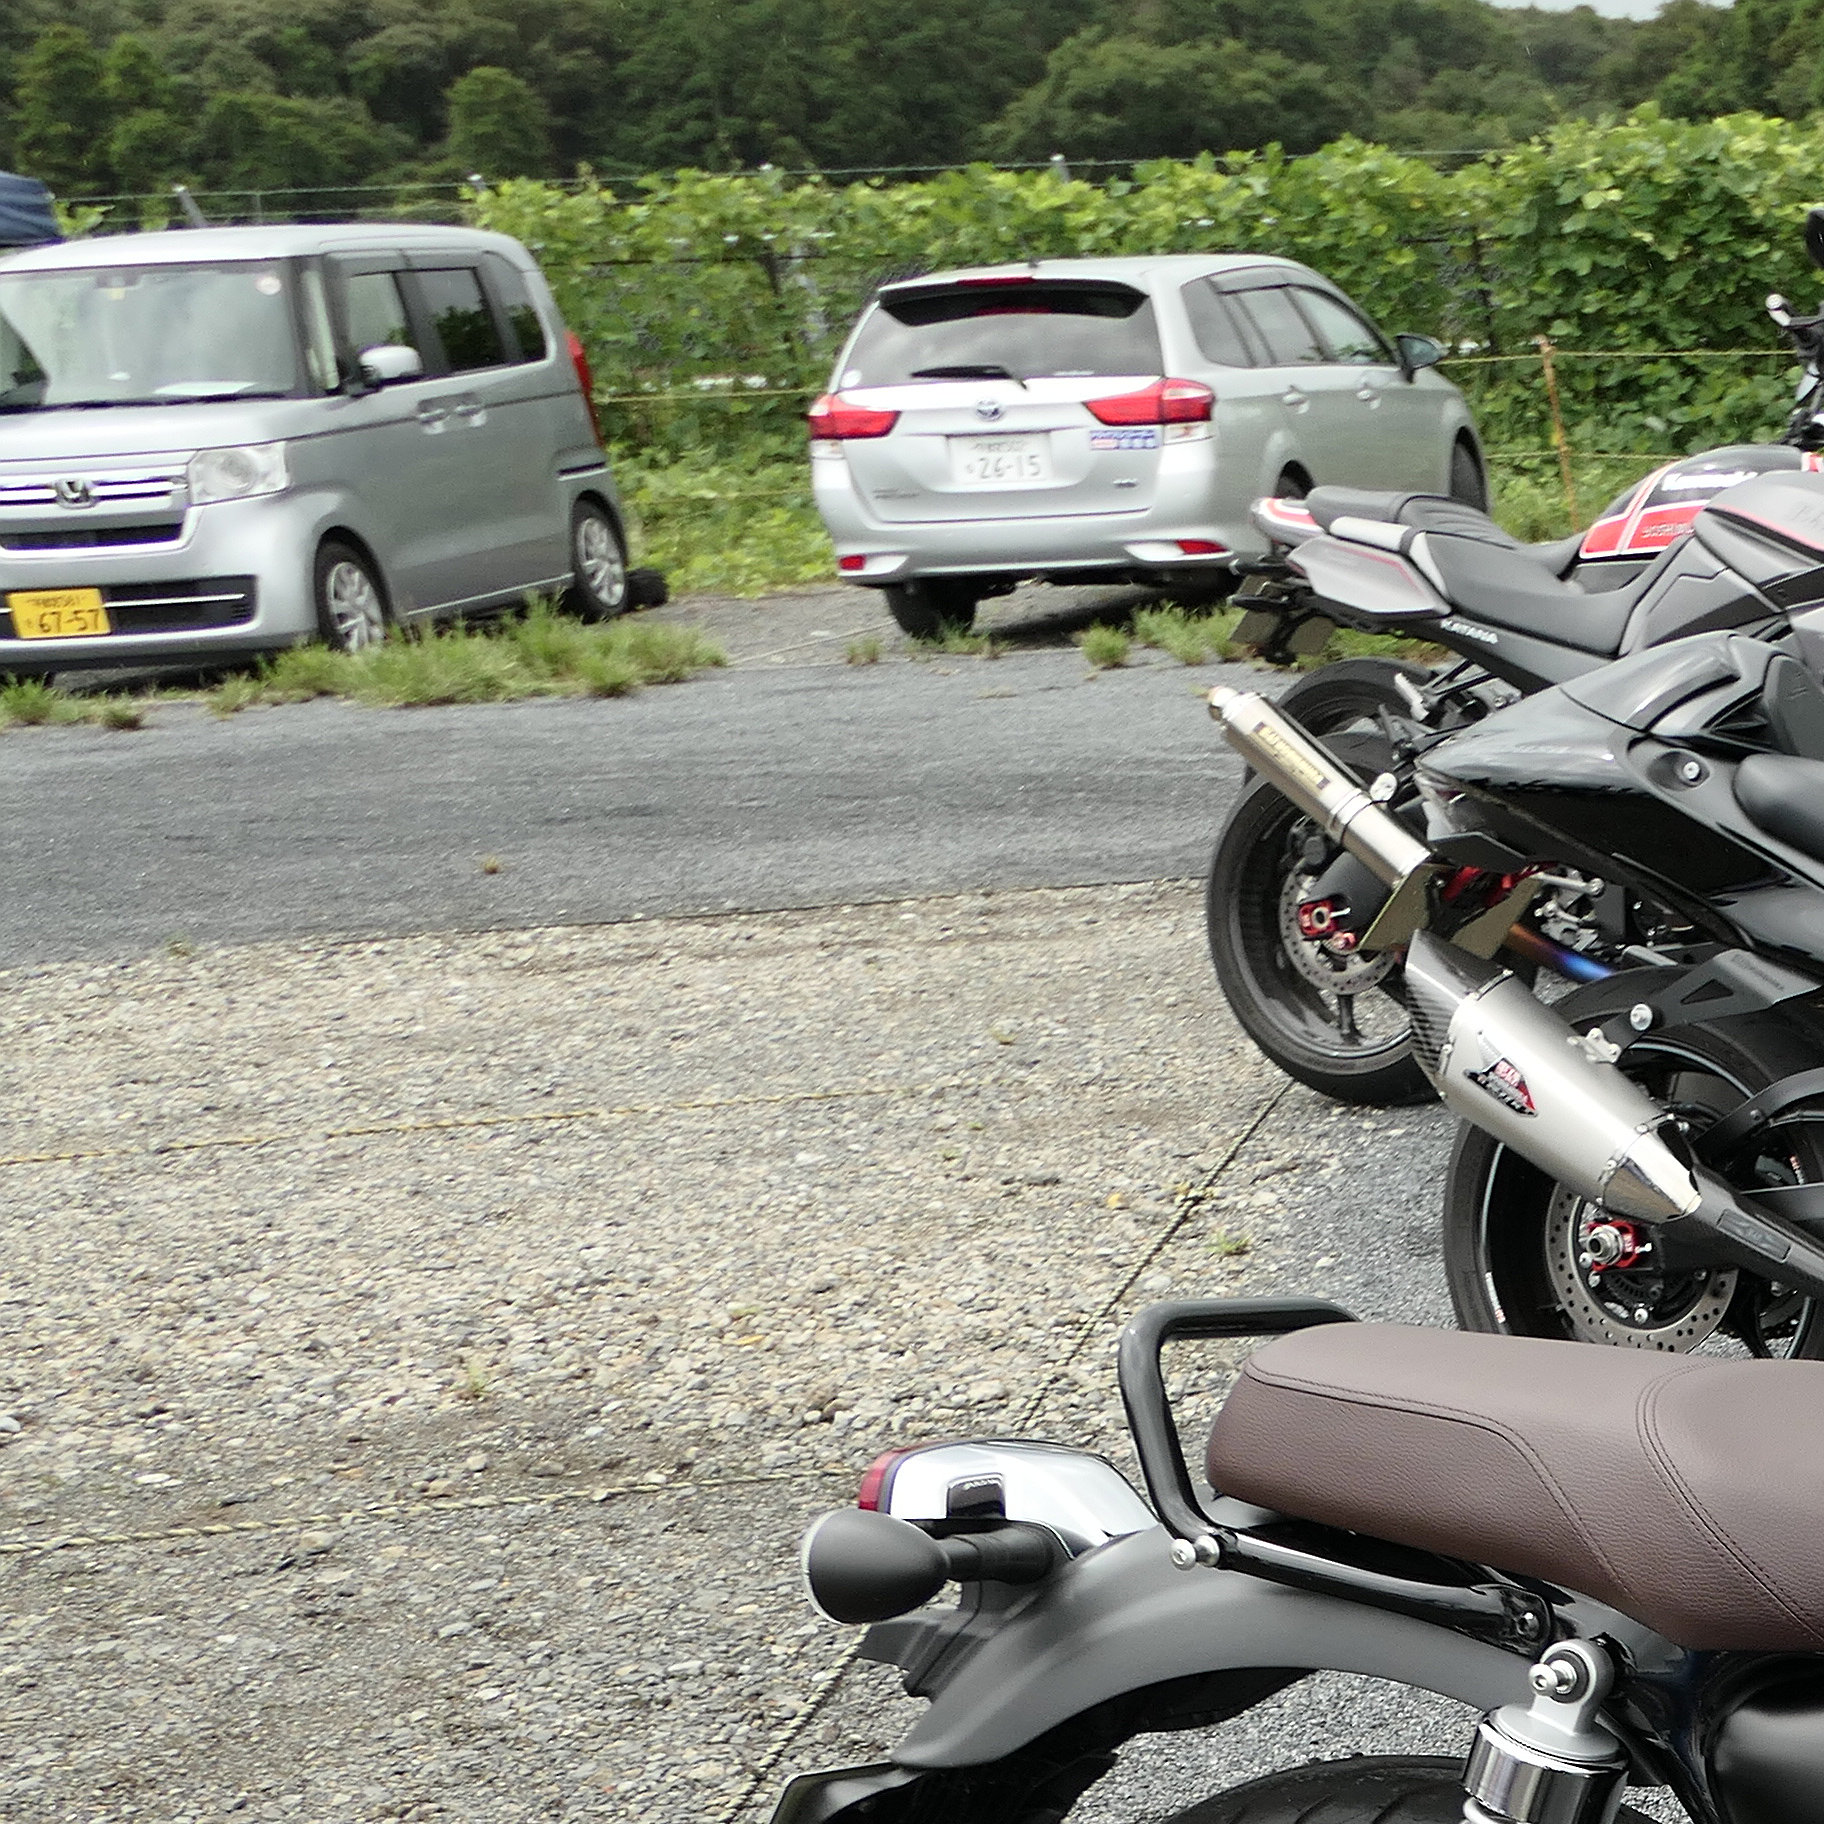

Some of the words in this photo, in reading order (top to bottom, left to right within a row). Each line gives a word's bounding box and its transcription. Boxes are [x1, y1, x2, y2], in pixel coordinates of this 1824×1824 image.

[978, 454, 1041, 480] 26-15
[38, 607, 100, 633] 67-57
[1440, 618, 1499, 645] KATANA
